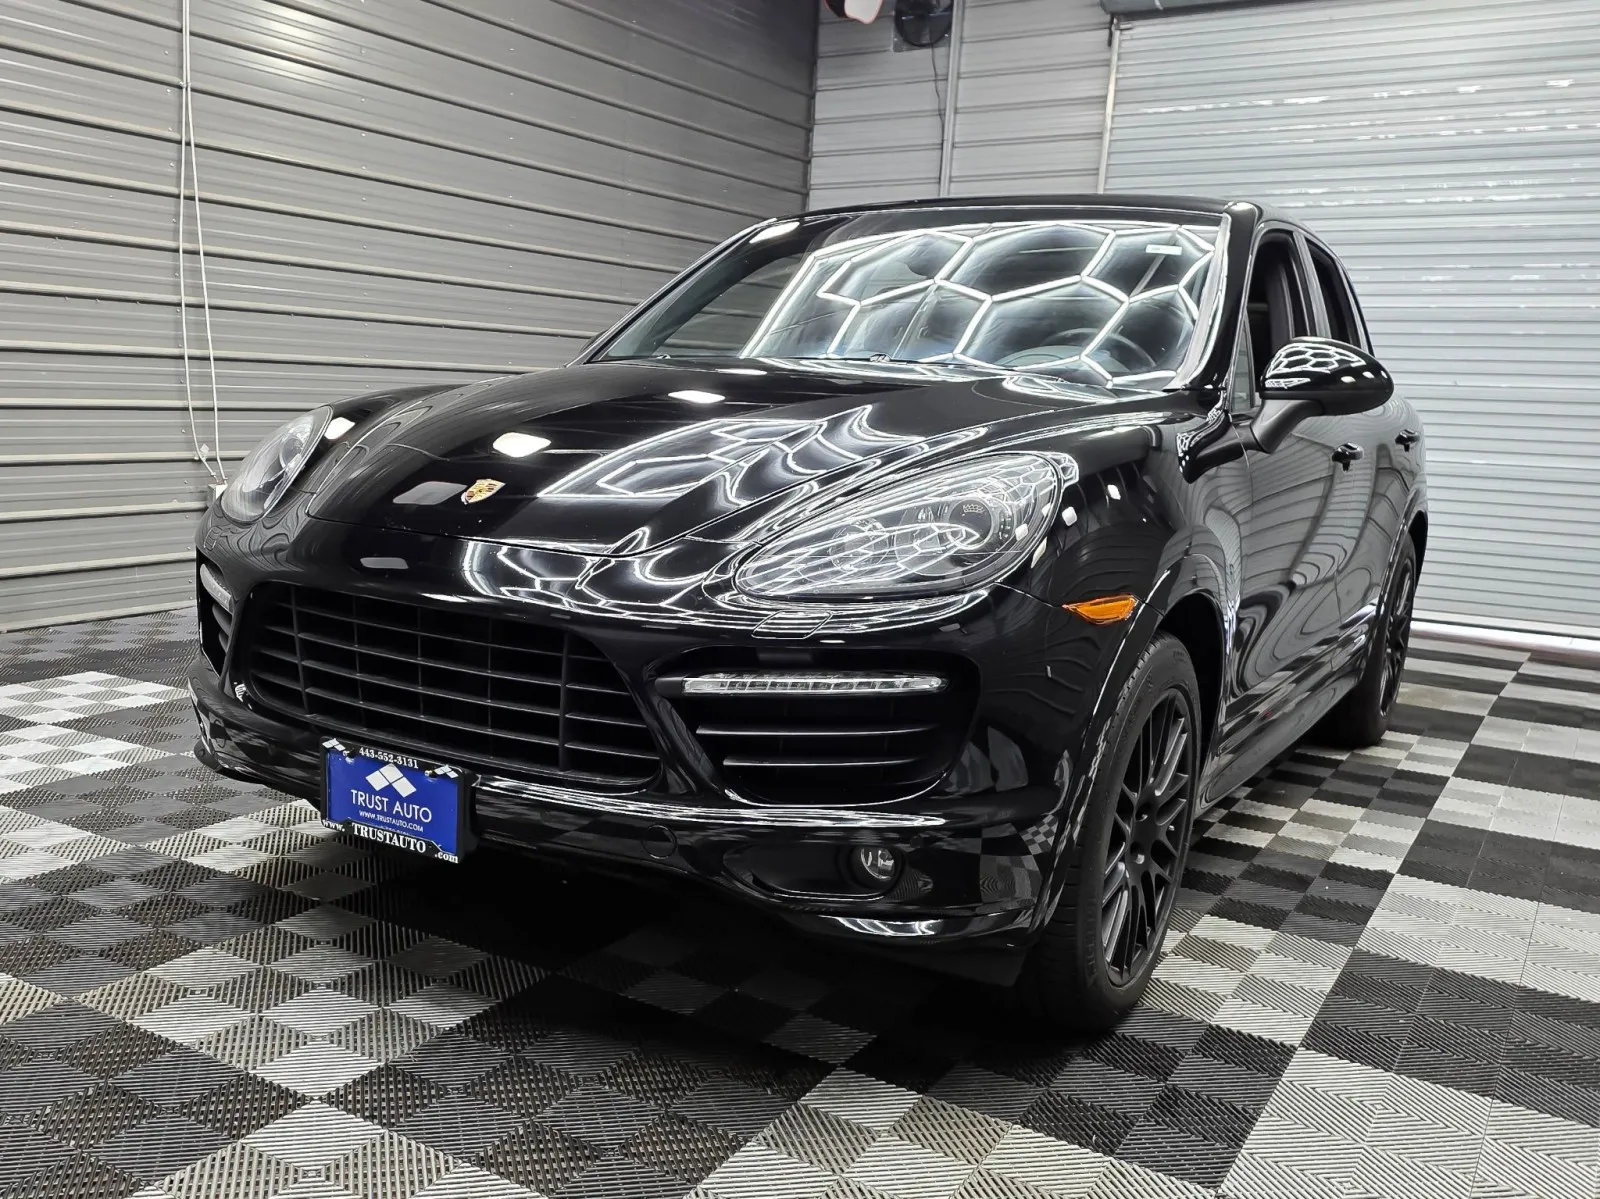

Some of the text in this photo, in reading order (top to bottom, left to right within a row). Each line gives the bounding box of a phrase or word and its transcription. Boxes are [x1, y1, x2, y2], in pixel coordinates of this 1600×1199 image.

[359, 747, 419, 769] 443-552-3131
[350, 789, 432, 823] TRUST AUTO
[358, 809, 424, 833] WWW.TRUSTAUTO.COM
[322, 819, 346, 832] www.
[351, 822, 427, 853] TRUSTAUTO
[434, 851, 459, 864] .com
